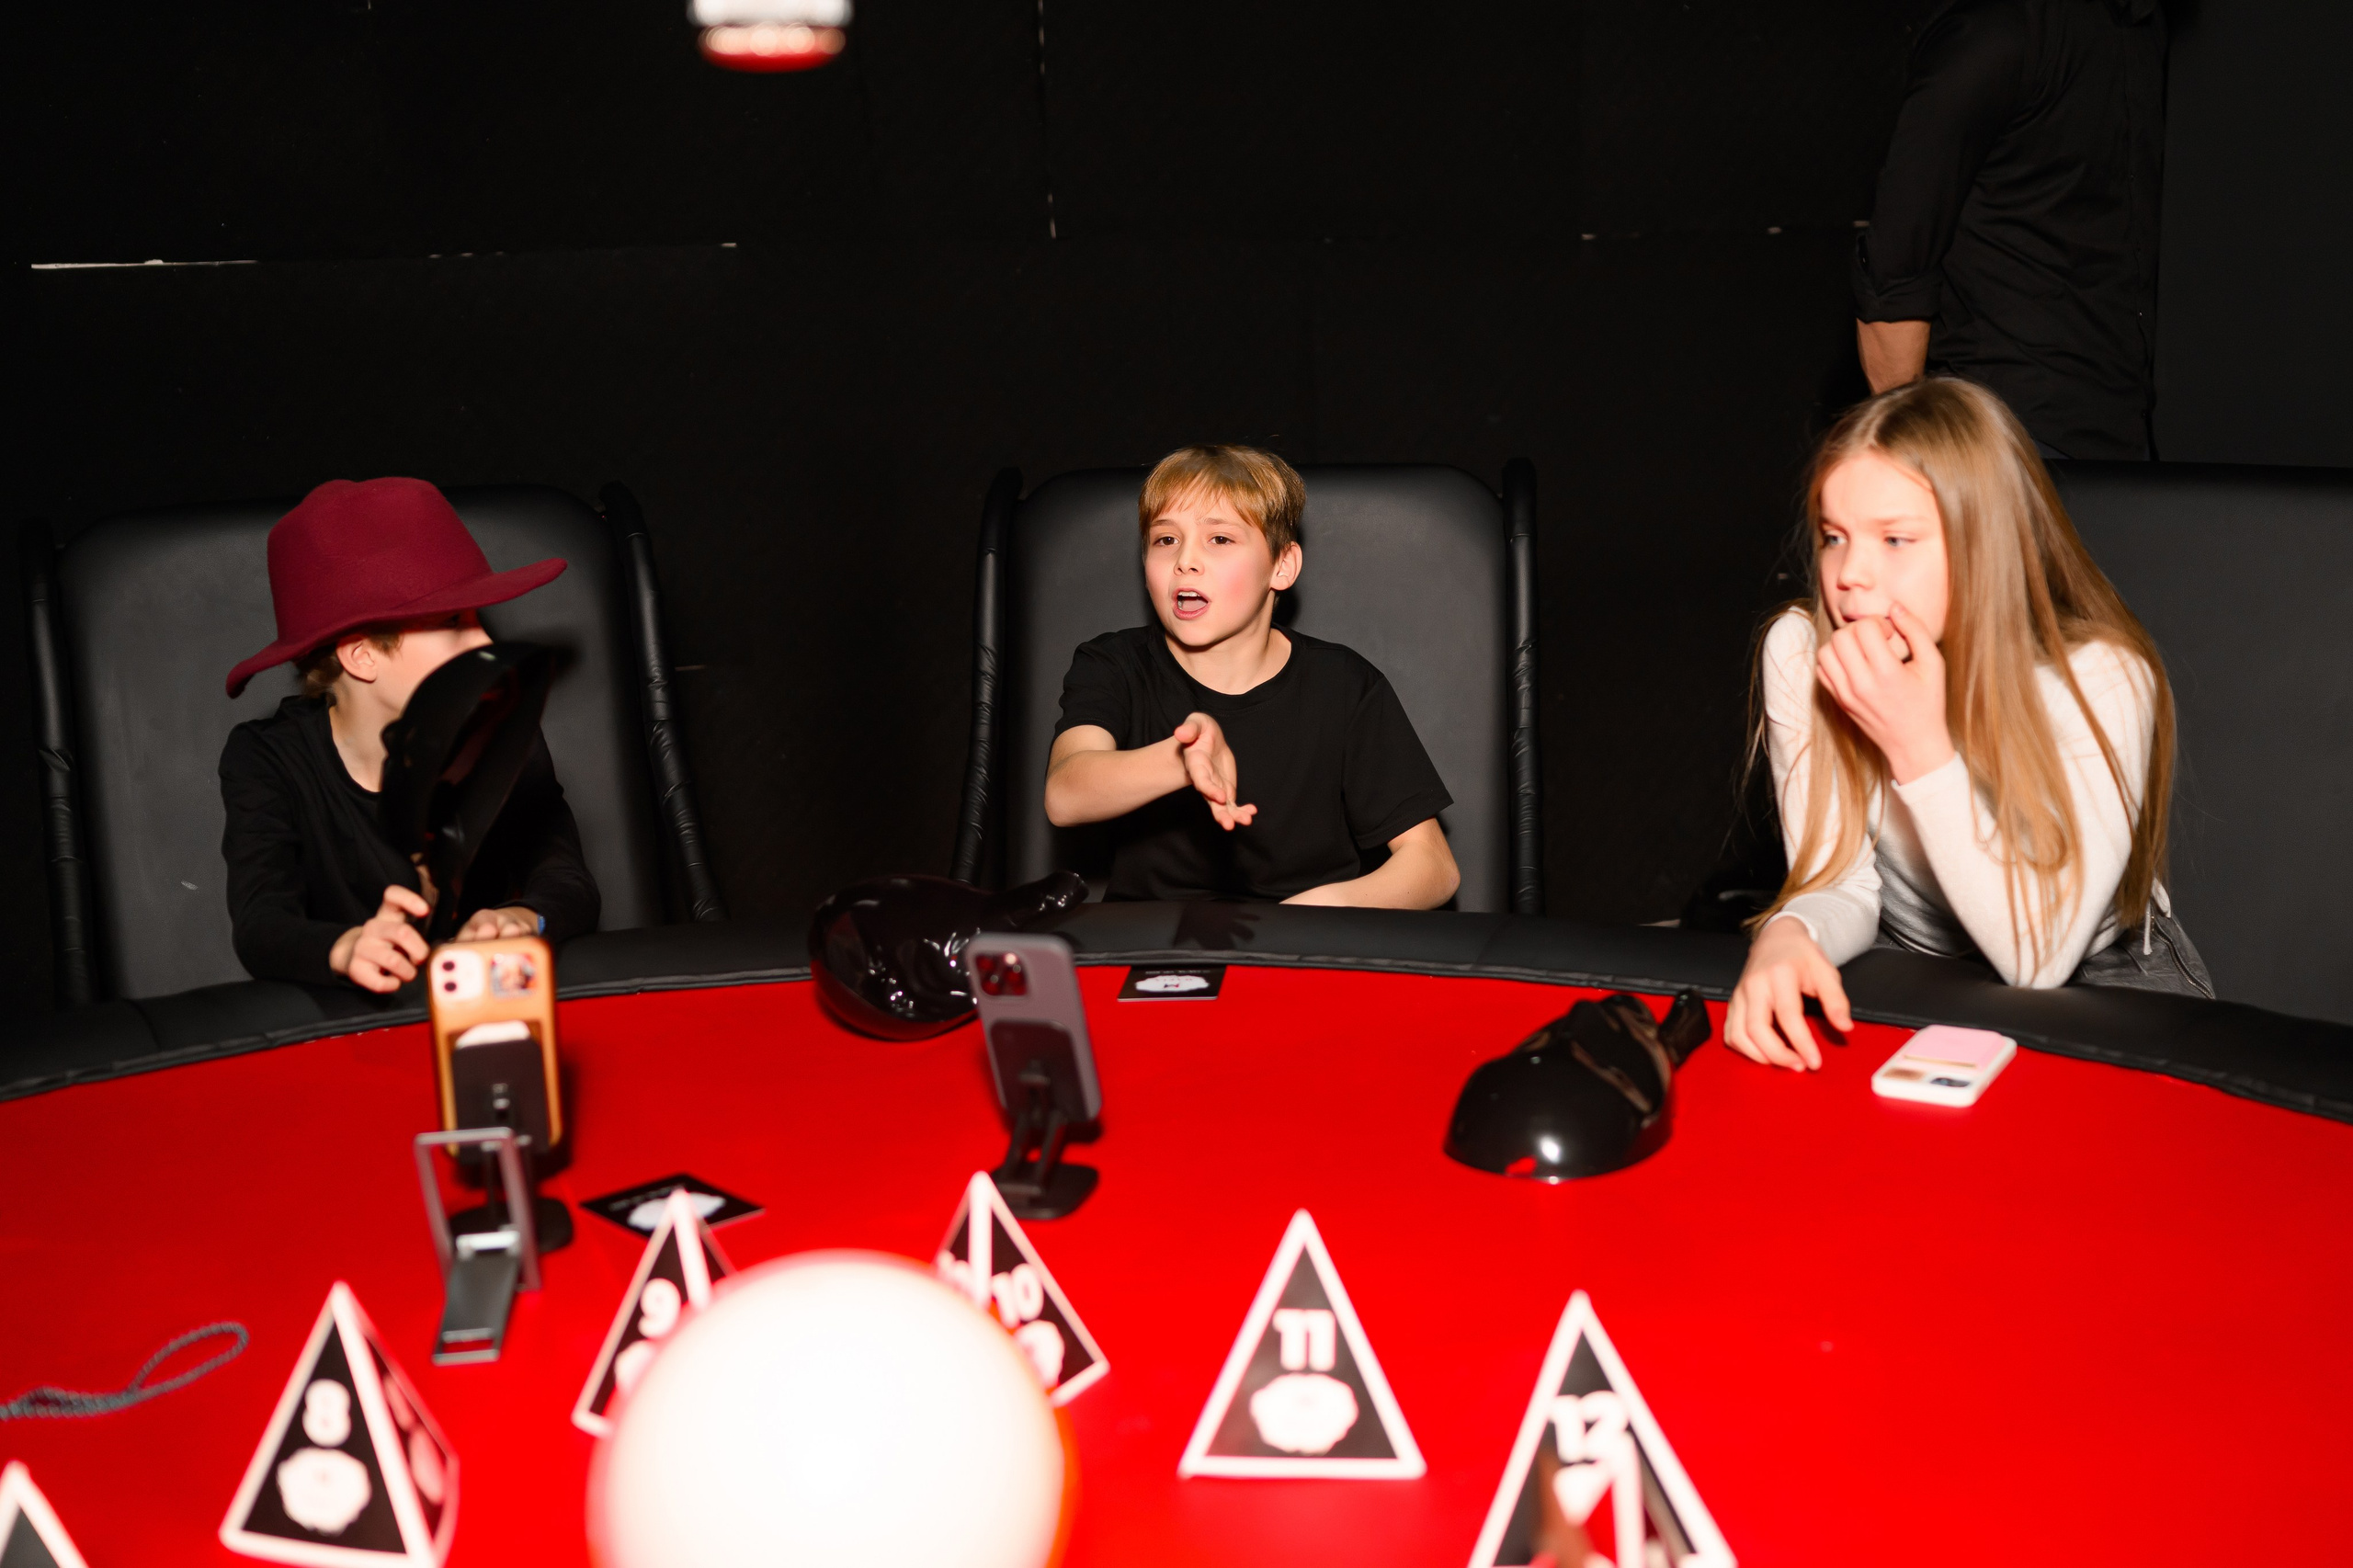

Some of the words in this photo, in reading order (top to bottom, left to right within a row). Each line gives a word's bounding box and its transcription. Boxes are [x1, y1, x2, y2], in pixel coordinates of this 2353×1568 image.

[638, 1278, 682, 1338] 9
[992, 1263, 1045, 1329] 10
[1272, 1308, 1336, 1372] 11
[302, 1379, 351, 1449] 8
[1552, 1390, 1630, 1463] 12
